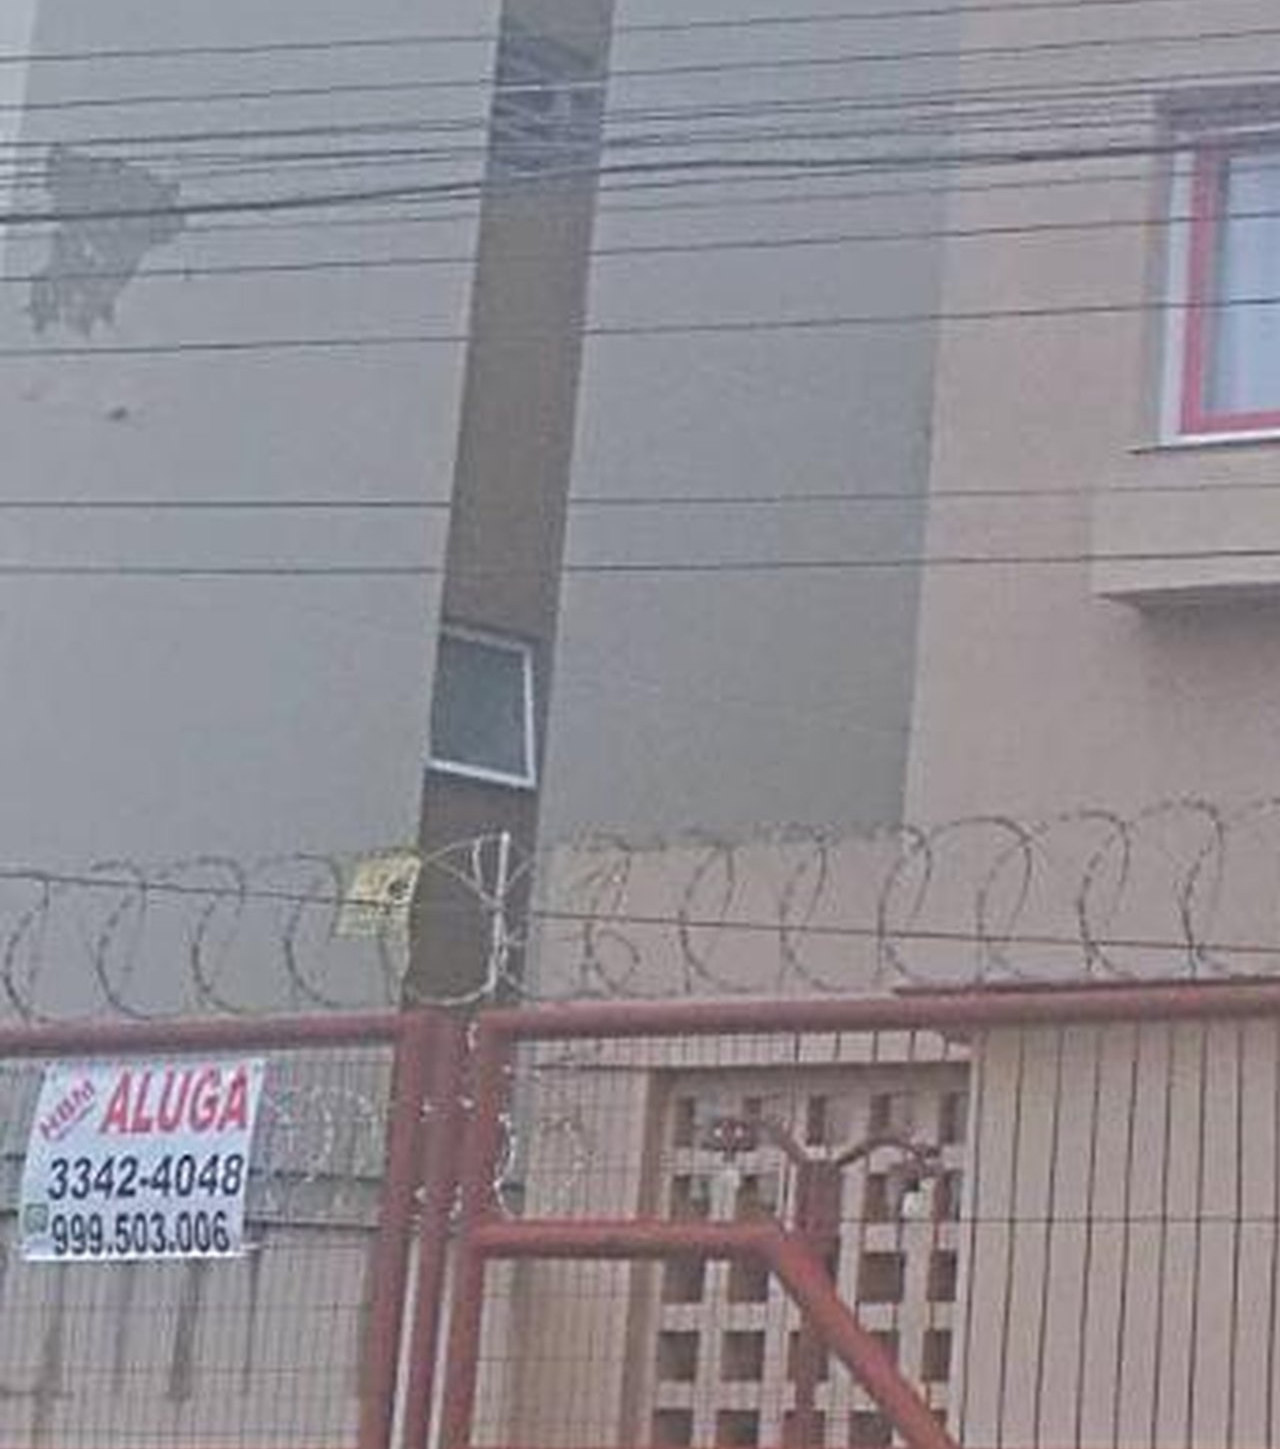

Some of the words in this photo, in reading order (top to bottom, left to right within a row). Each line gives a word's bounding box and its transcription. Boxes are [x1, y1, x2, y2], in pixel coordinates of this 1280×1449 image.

[100, 1065, 248, 1134] ALUGA
[48, 1154, 244, 1200] 3342-4048
[52, 1210, 230, 1255] 999.503.006
